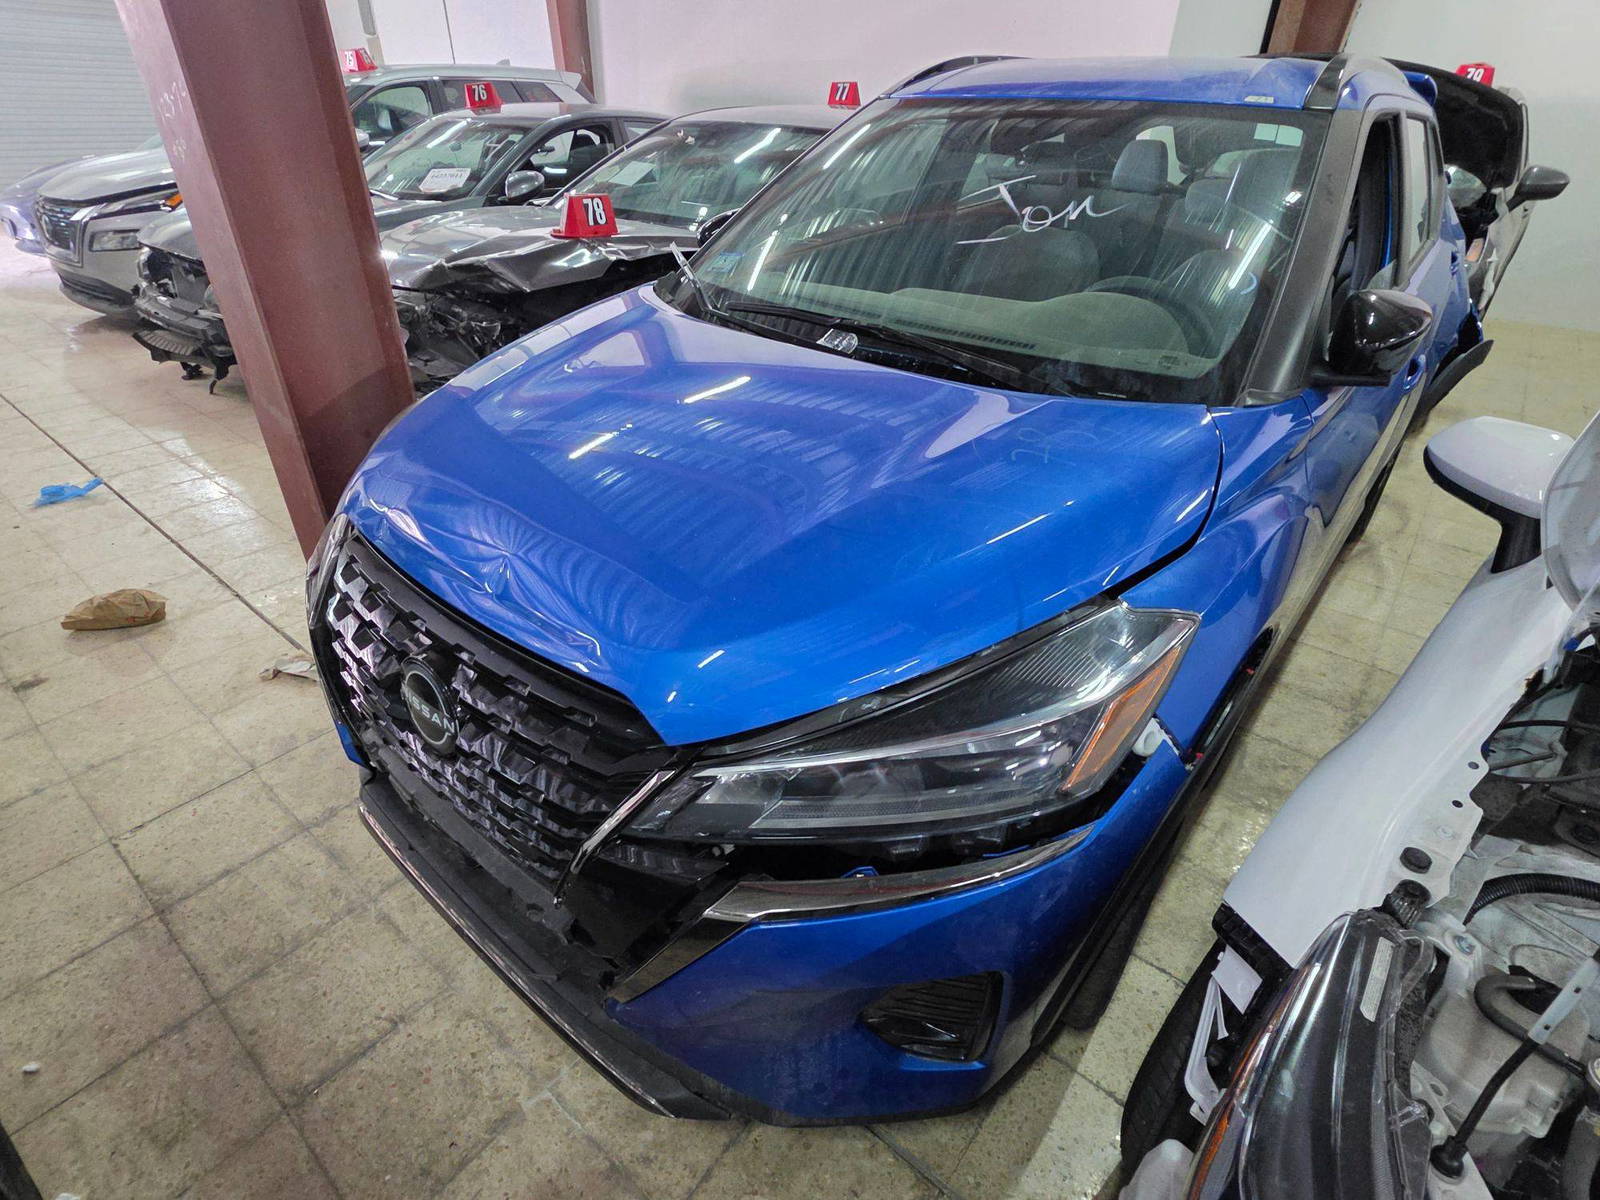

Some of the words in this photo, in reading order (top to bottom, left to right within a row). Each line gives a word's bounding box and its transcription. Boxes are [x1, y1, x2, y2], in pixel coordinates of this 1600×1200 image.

[472, 84, 487, 101] 76
[835, 83, 850, 101] 77
[582, 197, 607, 226] 78
[401, 682, 455, 734] NISSAN
